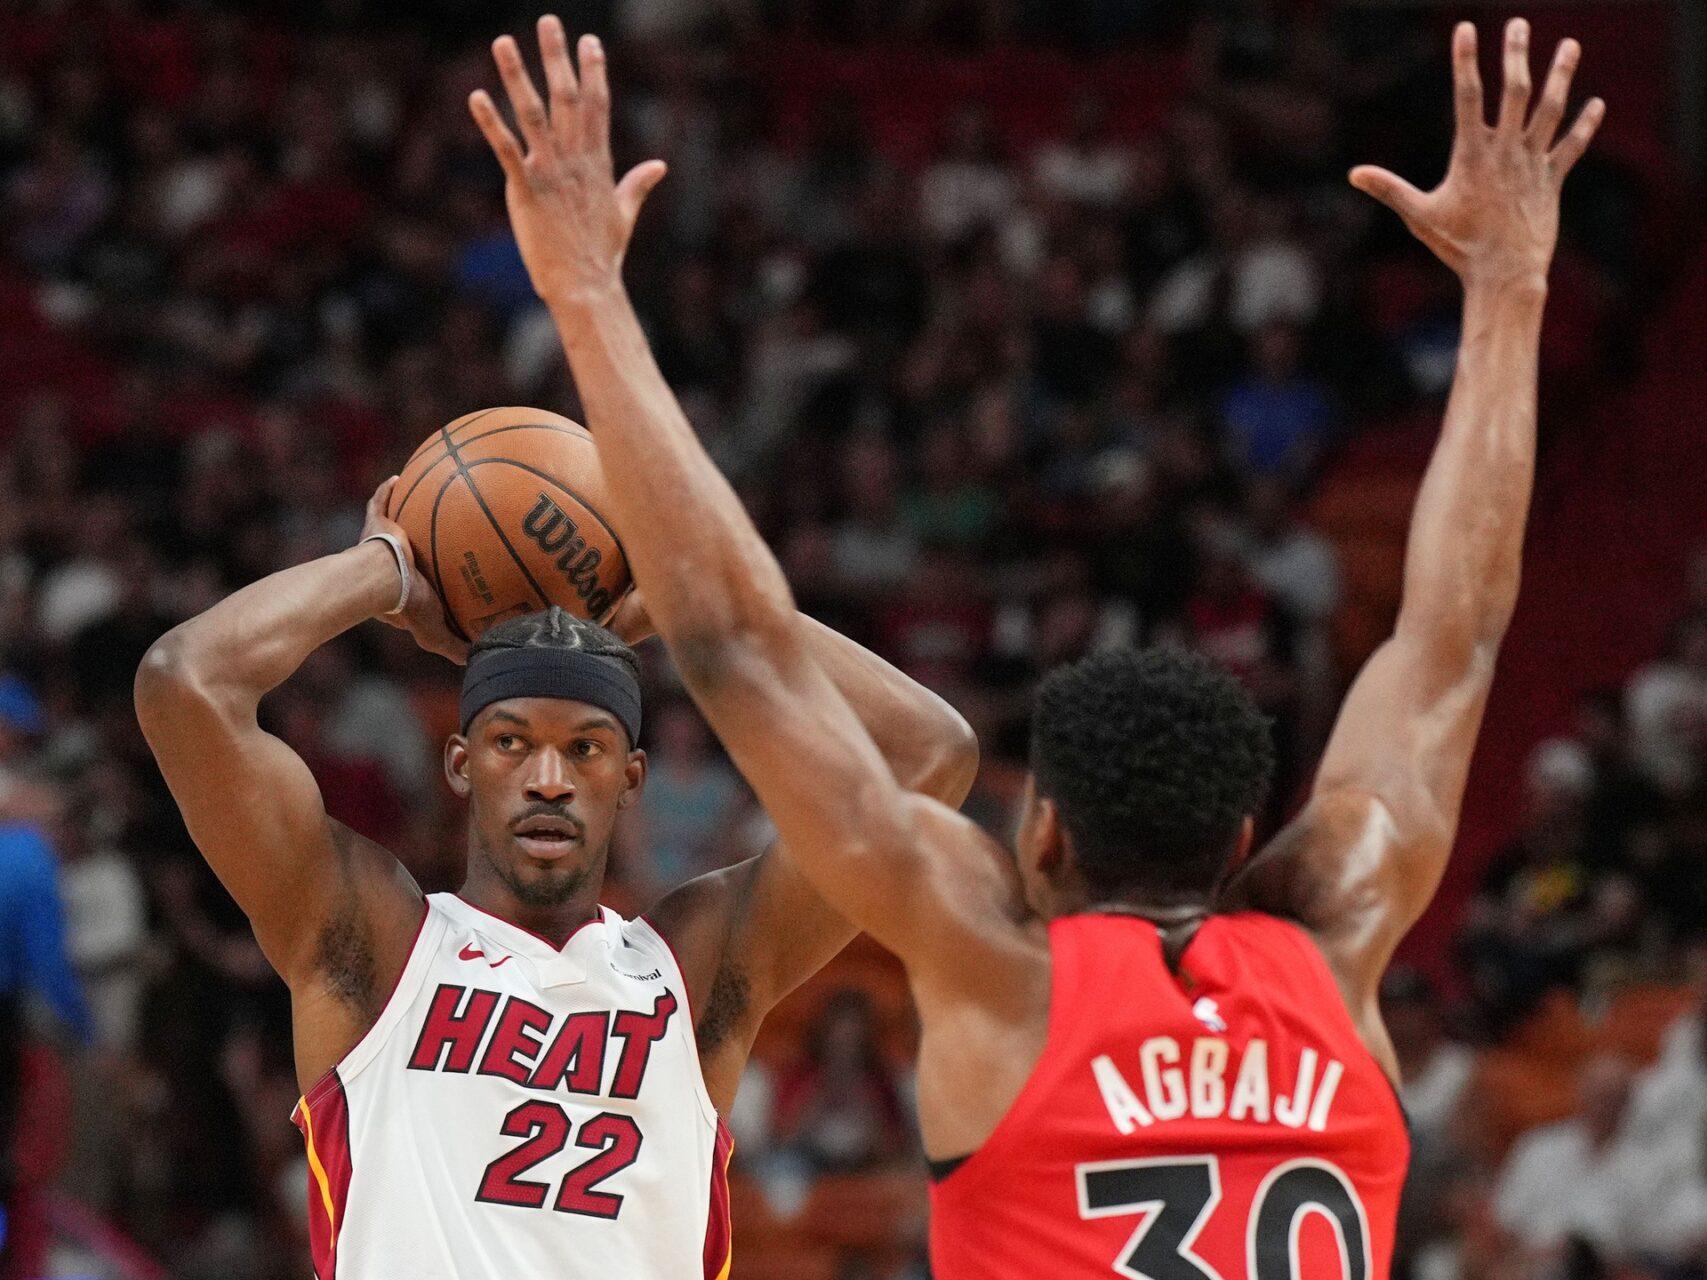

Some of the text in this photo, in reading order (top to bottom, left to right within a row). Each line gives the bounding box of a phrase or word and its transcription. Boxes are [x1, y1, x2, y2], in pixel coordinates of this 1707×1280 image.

[522, 491, 609, 619] Wilso
[406, 983, 678, 1100] HEAT
[1090, 1035, 1345, 1135] AGBAJI
[474, 1098, 644, 1221] 22
